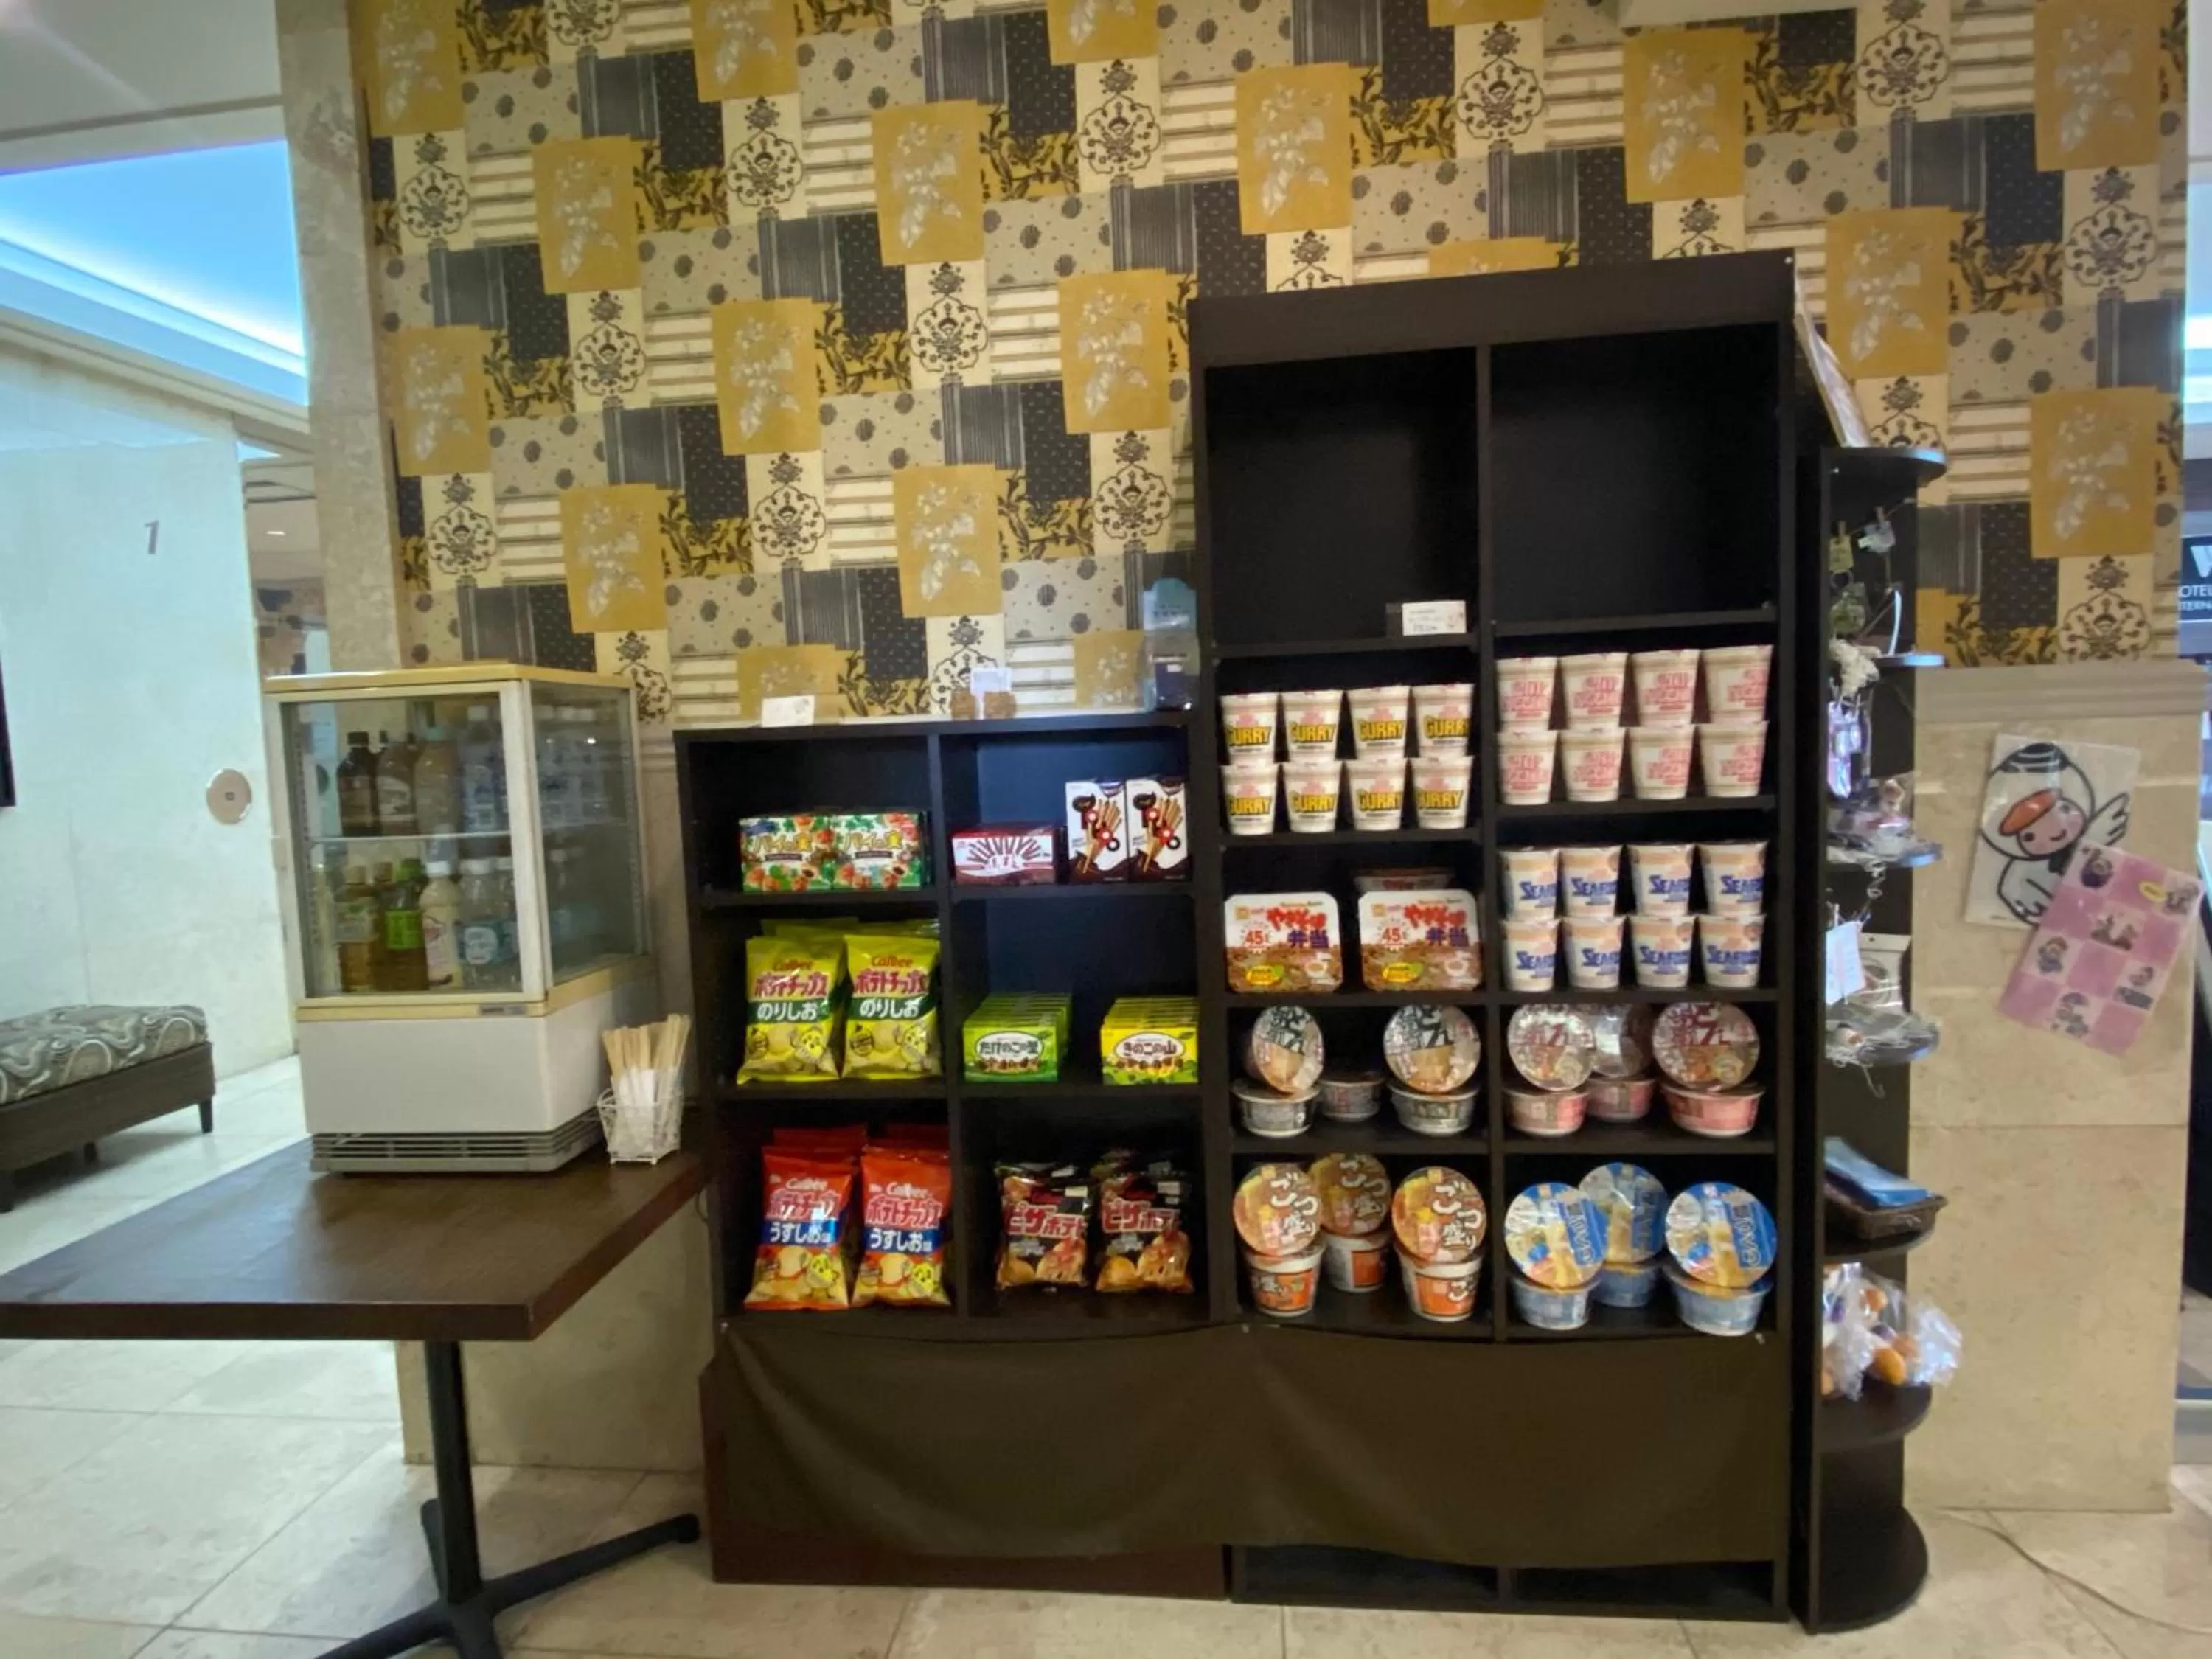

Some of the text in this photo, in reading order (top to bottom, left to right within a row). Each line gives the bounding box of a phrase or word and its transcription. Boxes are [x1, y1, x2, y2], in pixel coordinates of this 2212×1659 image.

[144, 519, 160, 555] 1
[1423, 715, 1470, 740] CURR
[757, 1002, 818, 1021] のりしお
[859, 998, 921, 1018] のりしお
